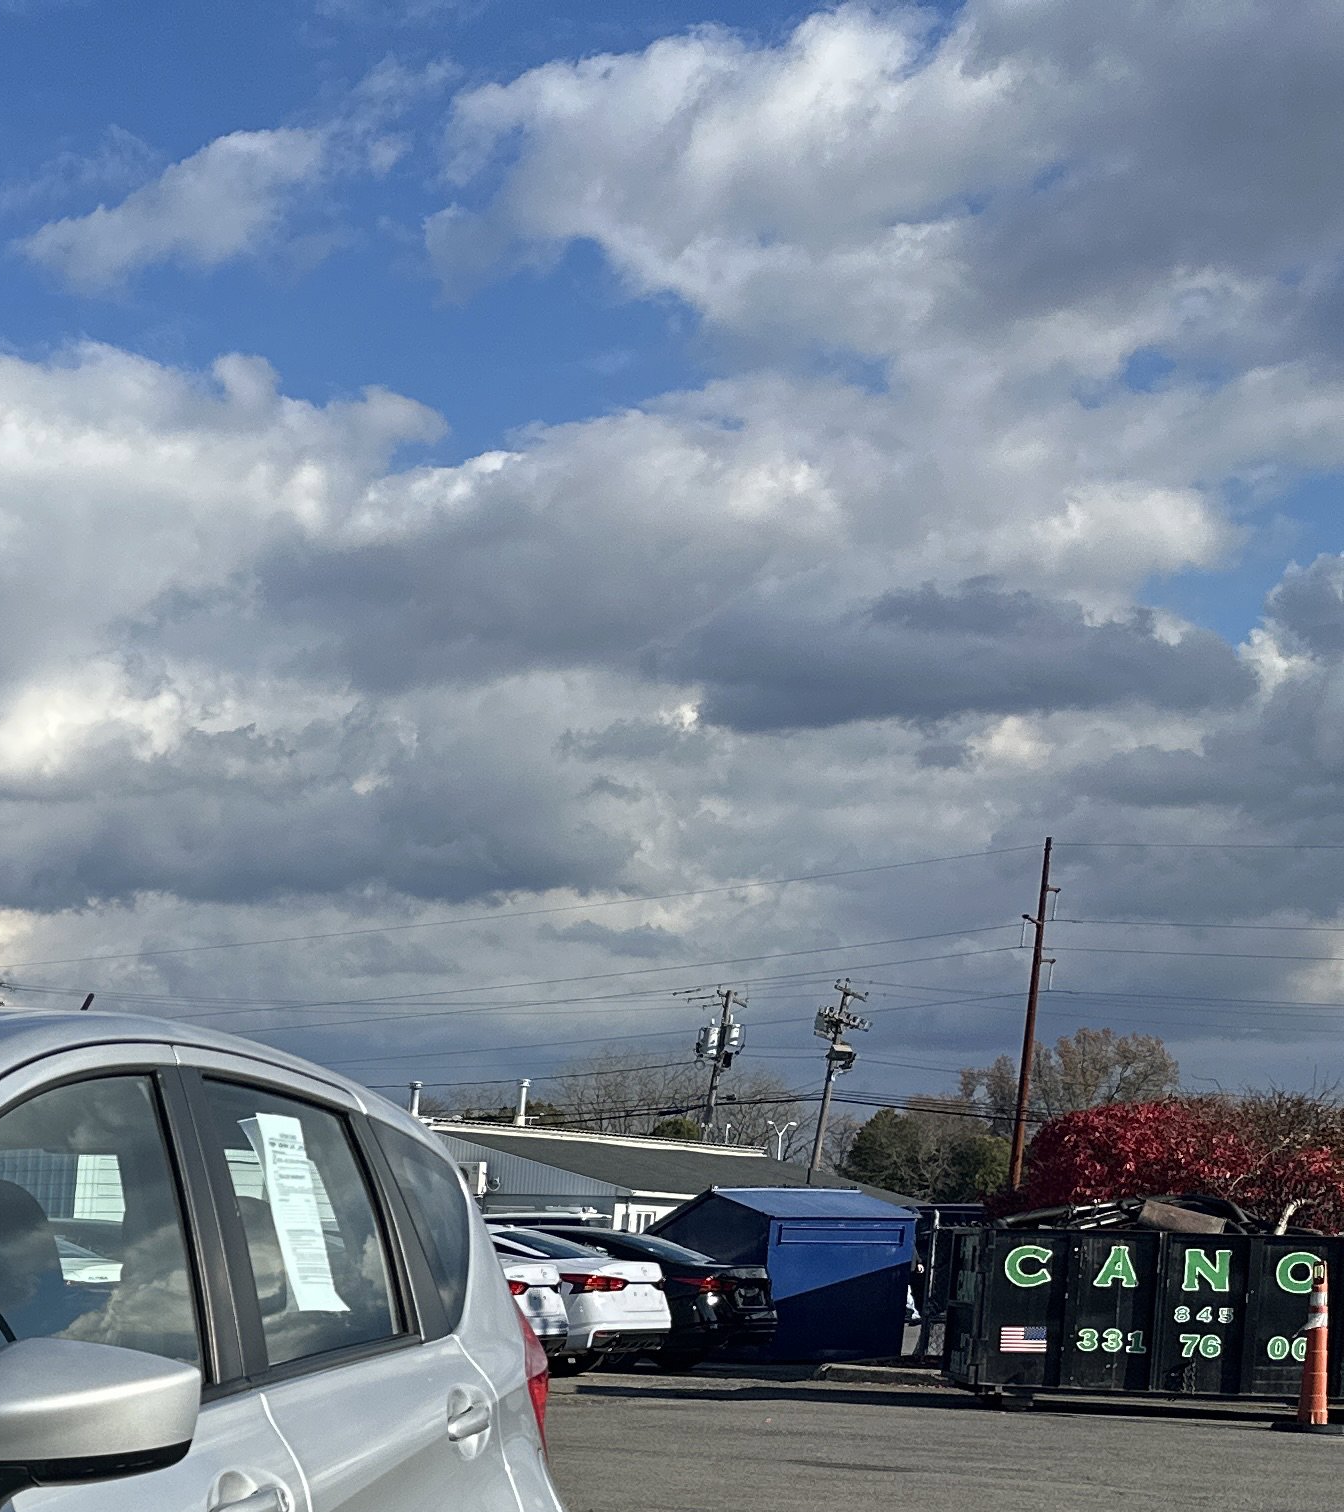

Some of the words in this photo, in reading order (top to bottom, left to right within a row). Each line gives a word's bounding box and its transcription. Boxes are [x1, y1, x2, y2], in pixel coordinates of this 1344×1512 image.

[1173, 1305, 1234, 1324] 845
[1076, 1328, 1147, 1353] 331
[1179, 1334, 1222, 1358] 76
